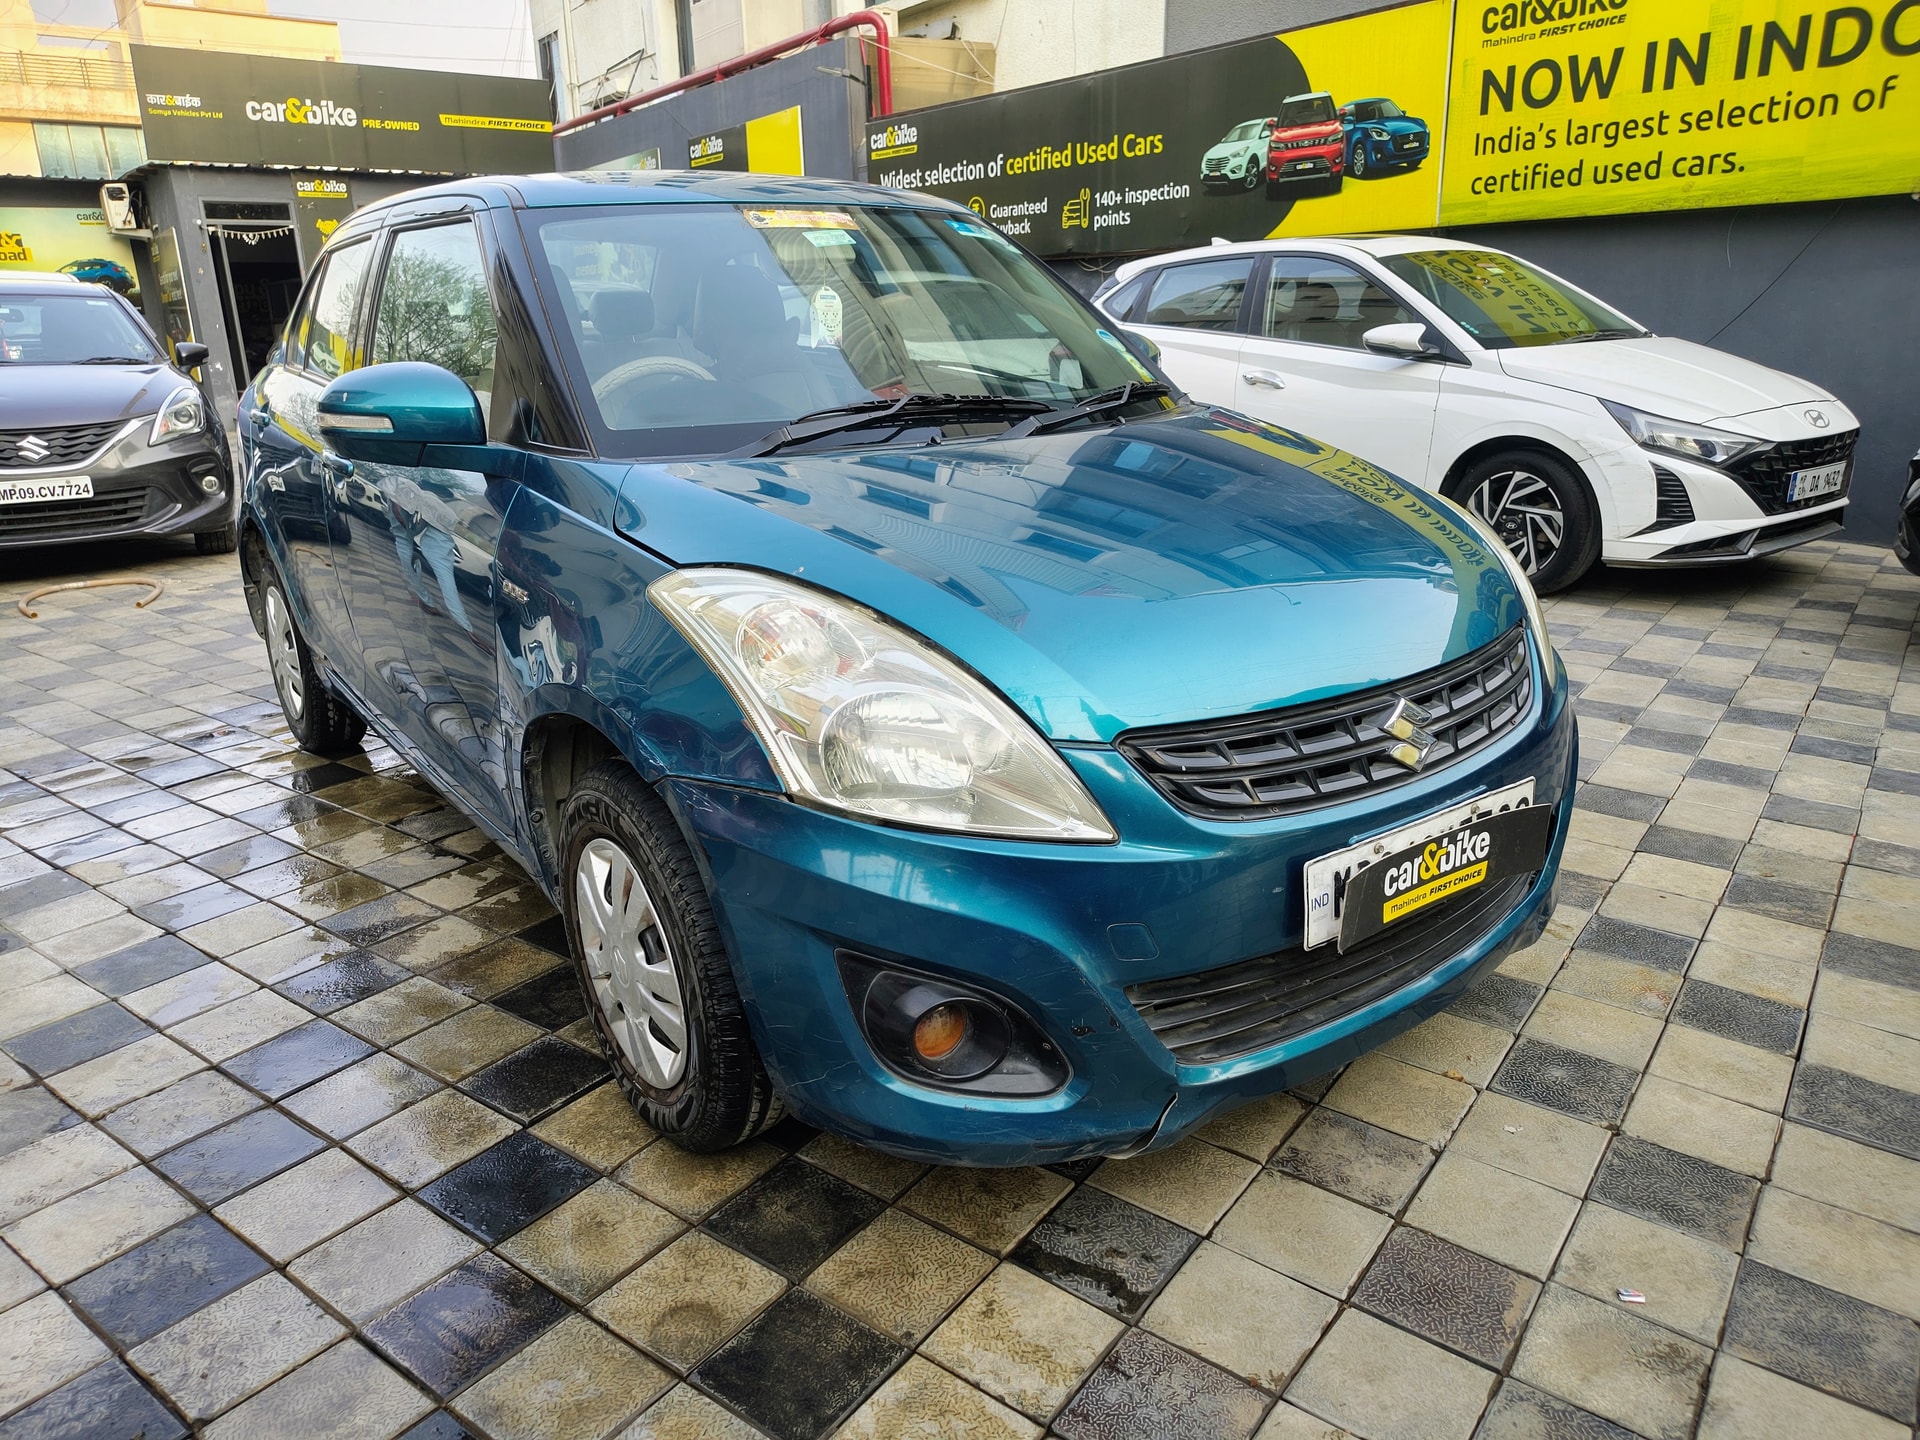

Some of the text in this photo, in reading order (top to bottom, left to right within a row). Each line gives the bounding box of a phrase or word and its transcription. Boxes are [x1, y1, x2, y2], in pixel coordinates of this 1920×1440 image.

[1539, 24, 1576, 38] FIRST
[1578, 14, 1628, 32] CHOICE
[1479, 0, 1920, 116] NOW IN INDO
[172, 109, 199, 118] Vehicles
[246, 97, 420, 131] car&bike PRE-OWNED
[1566, 110, 1670, 148] largest
[1677, 91, 1839, 134] selection
[1853, 75, 1899, 112] of
[690, 136, 723, 158] car&bike
[871, 124, 918, 149] car&bike
[880, 133, 1164, 189] Widest selection of certified Used Cars
[1471, 151, 1745, 195] certified used cars.
[296, 179, 347, 193] car&bike
[1094, 182, 1190, 208] 140+ inspection
[989, 197, 1048, 218] Guaranteed
[1094, 210, 1131, 231] points
[1384, 829, 1490, 896] car&bike
[1429, 880, 1453, 896] FIRST
[1453, 868, 1483, 886] CHOICE
[1311, 892, 1329, 911] IND
